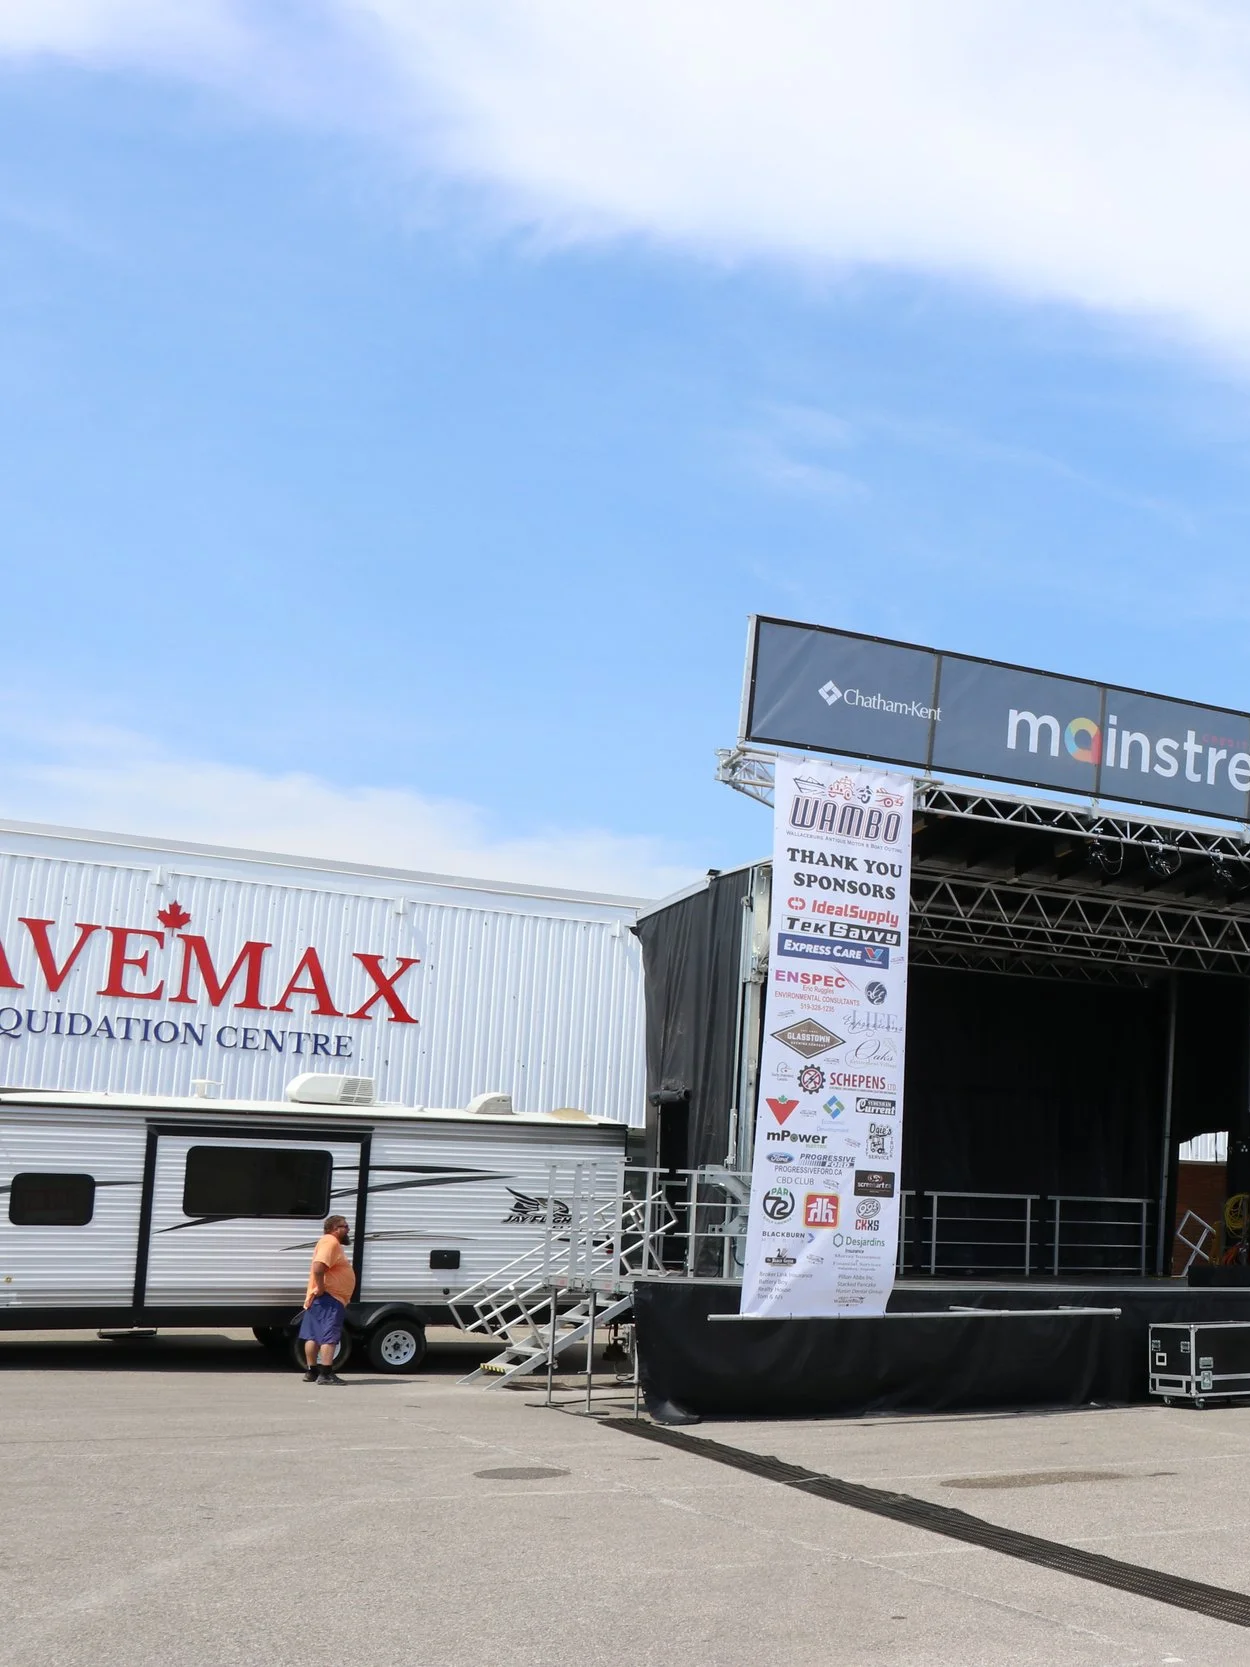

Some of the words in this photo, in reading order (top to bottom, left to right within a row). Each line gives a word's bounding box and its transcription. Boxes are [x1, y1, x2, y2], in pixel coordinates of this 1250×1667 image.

[843, 688, 942, 721] Chatham-Kent
[790, 796, 902, 843] WAMBO
[787, 847, 858, 872] THANK
[863, 859, 903, 878] YOU
[794, 872, 896, 900] SPONSORS
[811, 899, 899, 928] IdealSupply
[783, 939, 831, 956] EXPRESS
[832, 945, 862, 960] CARE
[774, 970, 846, 989] ENSPEC
[774, 991, 821, 1002] ENVIRONMENTAL
[821, 996, 860, 1007] CONSULTANTS
[216, 1025, 354, 1058] CENTRE
[787, 1032, 831, 1043] GLASSTOWN
[830, 1072, 887, 1090] SCHEPENS
[856, 1099, 896, 1116] Current
[766, 1130, 828, 1144] mPower
[800, 1153, 857, 1163] PROGRESSIVE
[774, 1165, 843, 1176] PROGRESSIVEFORD.CA
[776, 1176, 794, 1185] CBD
[794, 1177, 815, 1186] CLUB
[770, 1187, 789, 1196] PAR
[530, 1215, 572, 1224] FLGH
[855, 1219, 880, 1231] CKXS
[762, 1230, 806, 1239] BLACKBURN
[846, 1236, 886, 1248] Desjardins
